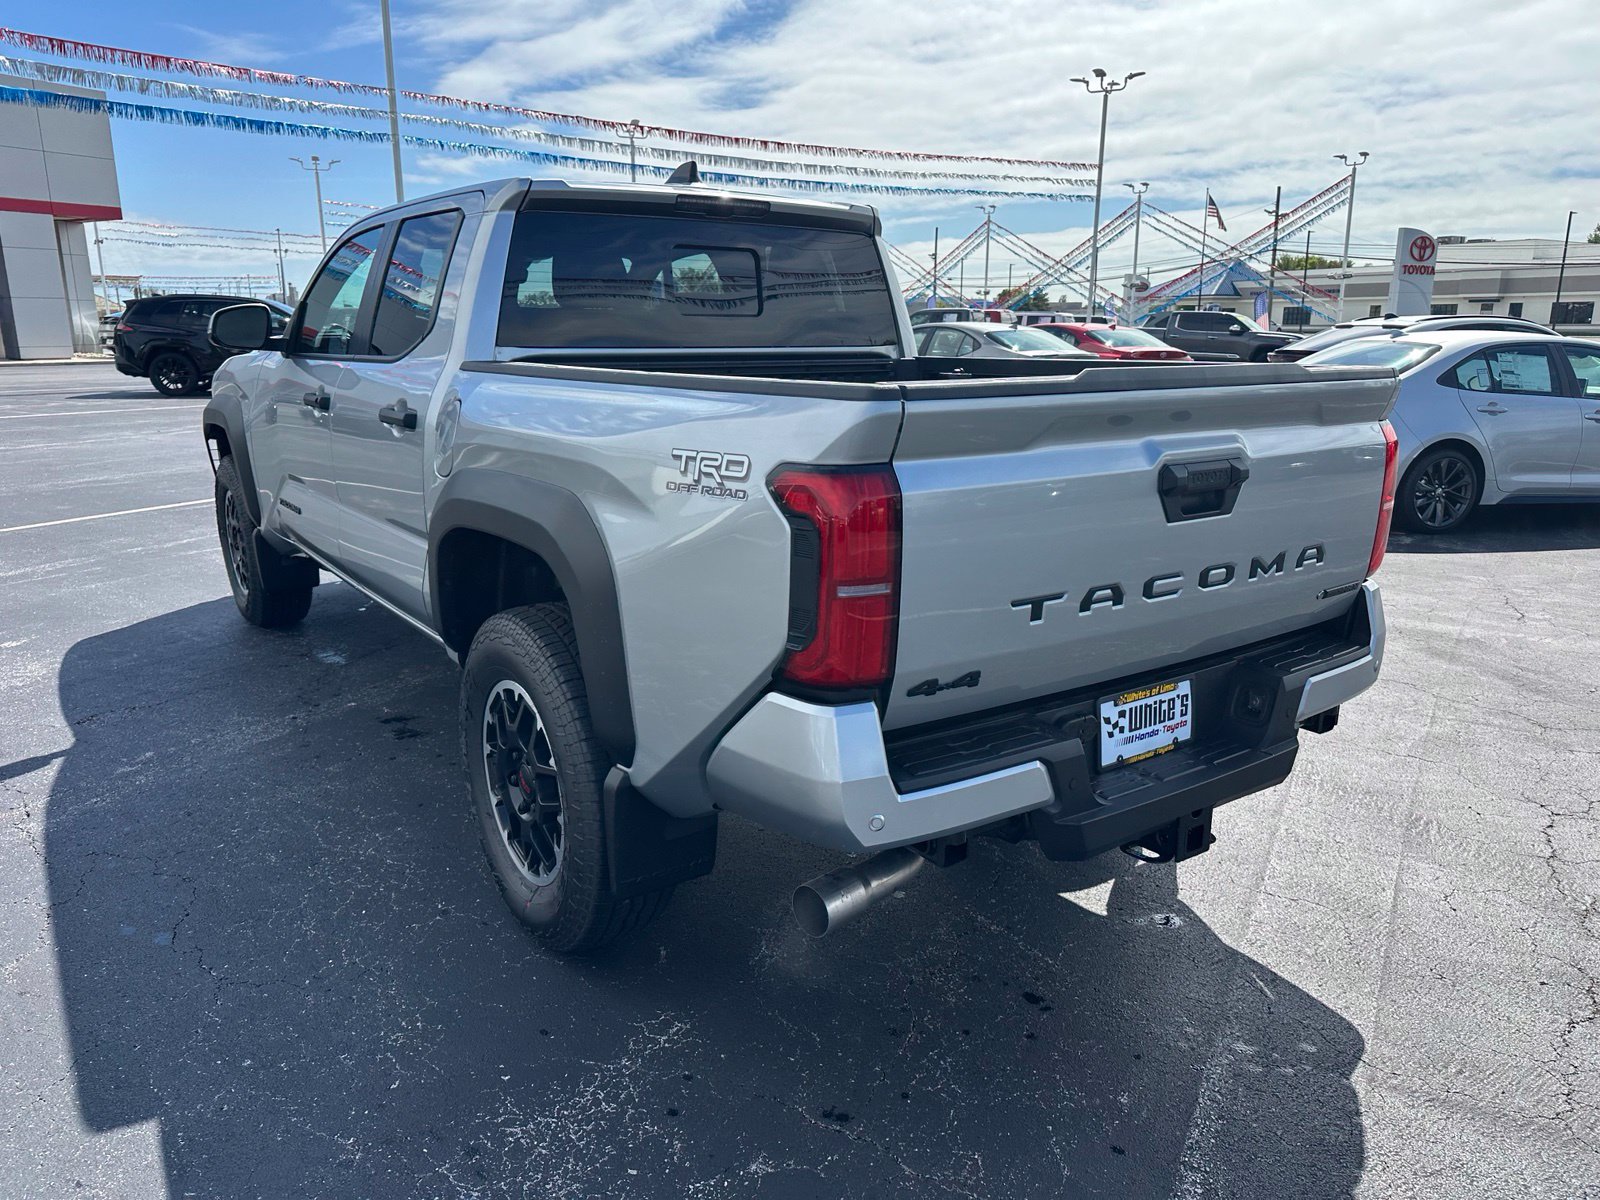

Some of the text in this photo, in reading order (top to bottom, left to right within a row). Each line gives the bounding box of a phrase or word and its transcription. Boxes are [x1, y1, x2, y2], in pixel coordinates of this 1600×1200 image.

[1402, 264, 1436, 276] TOYOTA
[671, 447, 752, 488] TRD
[666, 481, 748, 501] OFF ROAD
[1010, 543, 1326, 626] TACOMA
[1151, 686, 1160, 696] of
[1134, 719, 1188, 742] Honda Toyota
